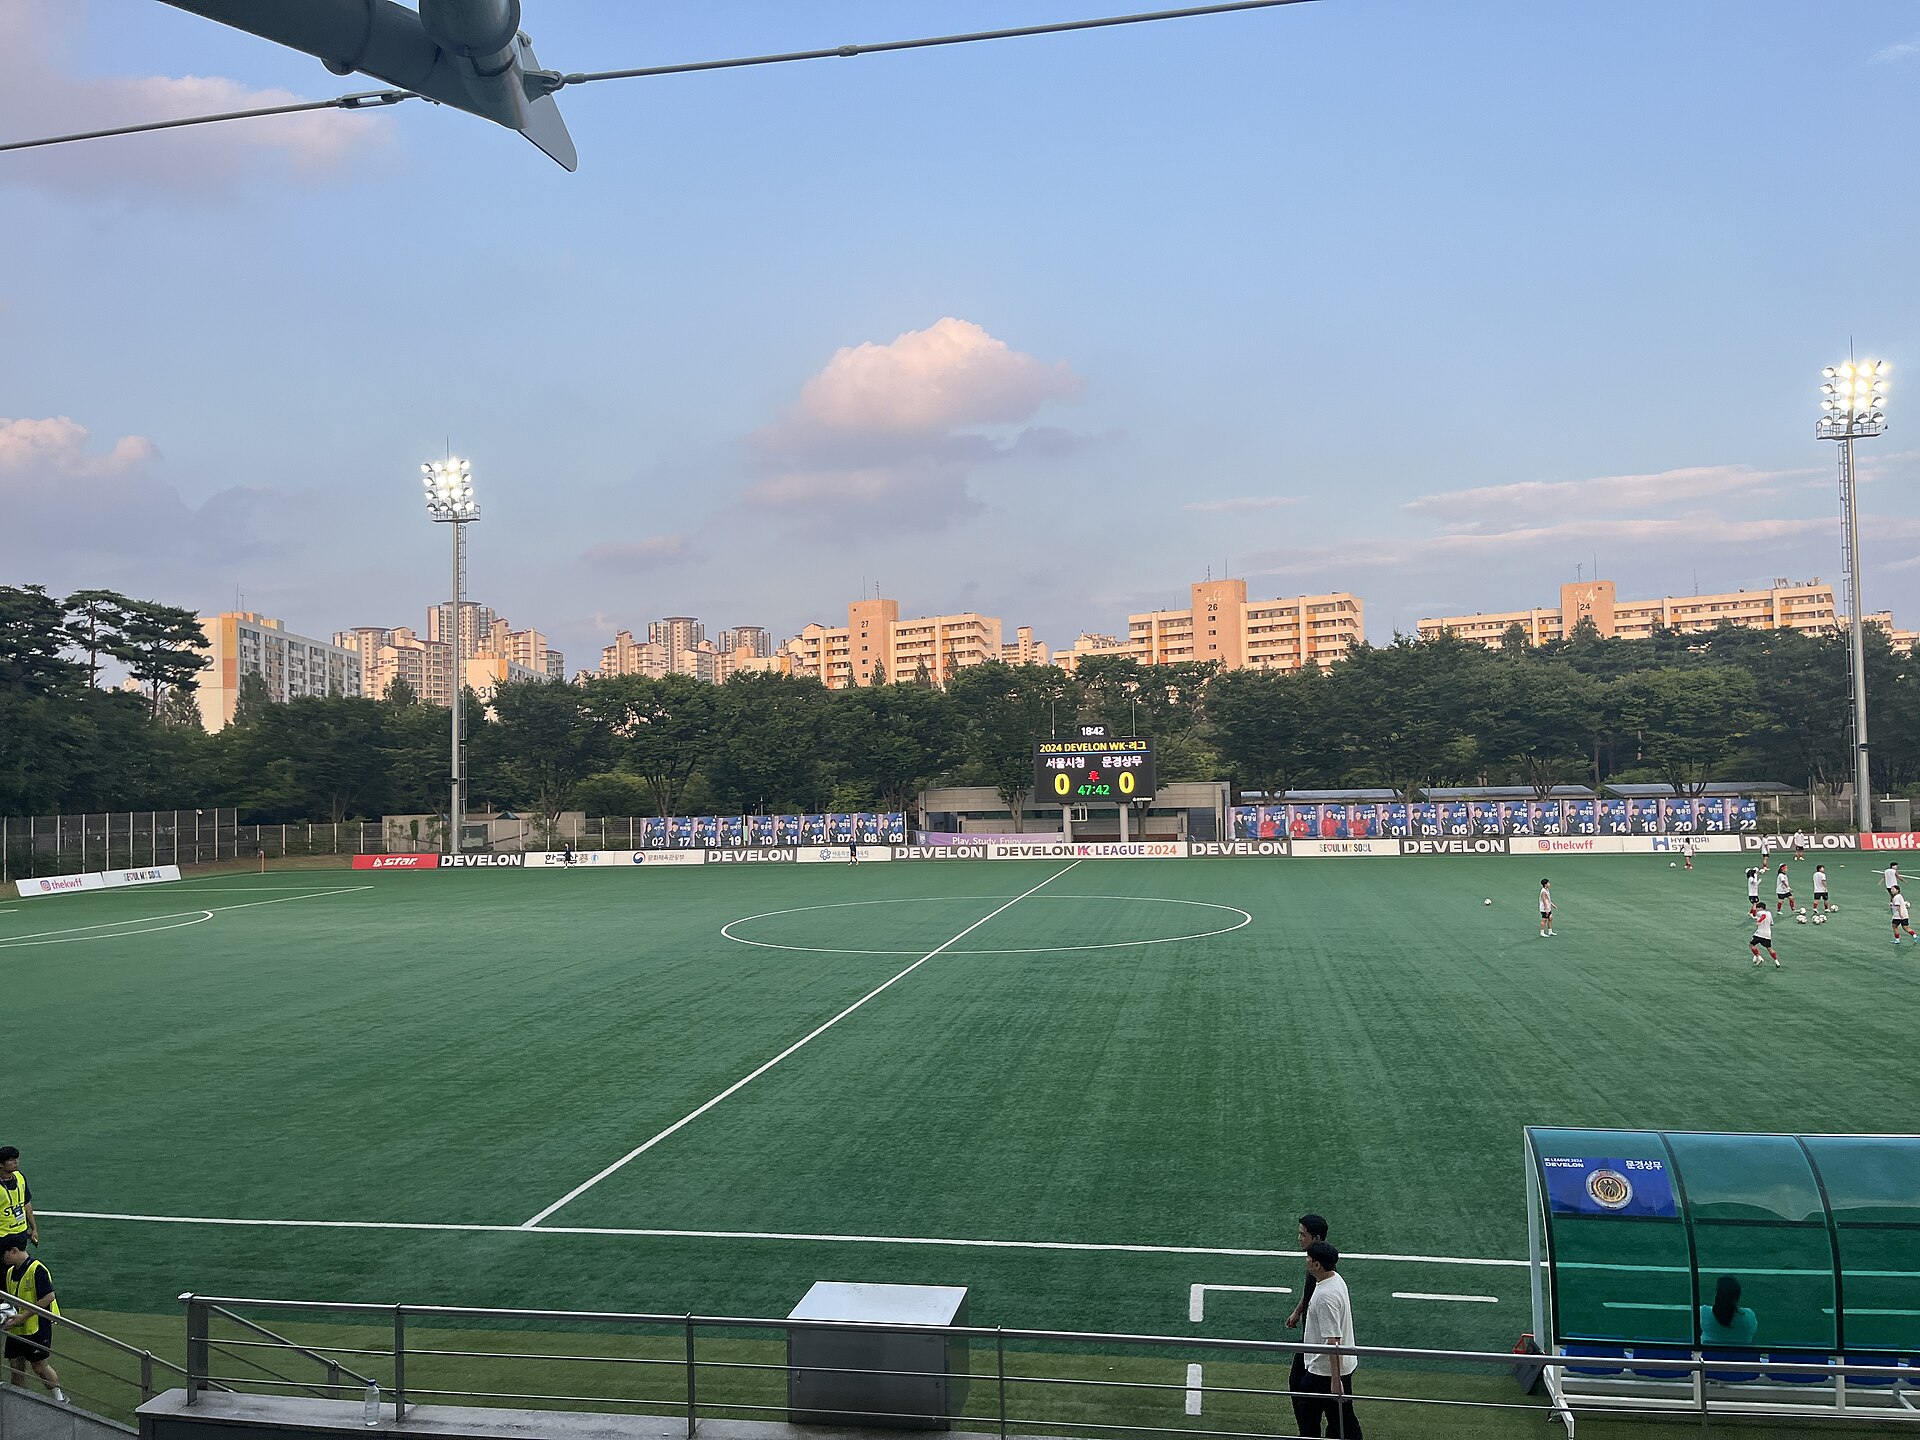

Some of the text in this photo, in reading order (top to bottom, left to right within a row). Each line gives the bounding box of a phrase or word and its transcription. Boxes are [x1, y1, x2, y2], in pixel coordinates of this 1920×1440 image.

[1207, 603, 1218, 611] 26
[861, 620, 869, 628] 27
[478, 686, 493, 698] 31
[1081, 726, 1105, 736] 18:42
[1040, 741, 1147, 752] 2024 DEVELON WK-리그
[1046, 756, 1085, 769] 서울시청
[1101, 755, 1143, 768] 문경상무
[1054, 773, 1070, 795] 0
[1118, 771, 1135, 794] 0
[1077, 784, 1111, 796] 47:42
[1421, 824, 1437, 835] 05
[1451, 824, 1467, 835] 06
[1483, 824, 1499, 833] 23
[1513, 823, 1529, 833] 24
[1543, 823, 1560, 834] 26
[1579, 822, 1594, 833] 13
[1610, 822, 1626, 832] 14
[1642, 821, 1657, 832] 16
[1675, 821, 1692, 831] 20
[1706, 820, 1723, 831] 21
[1740, 820, 1756, 830] 22
[1391, 826, 1406, 835] 01
[652, 837, 664, 846] 02
[678, 837, 690, 846] 17
[703, 837, 716, 846] 18
[729, 836, 741, 845] 19
[760, 836, 772, 845] 10
[785, 836, 798, 844] 11
[811, 834, 824, 843] 12
[837, 834, 851, 842] 07
[864, 833, 877, 842] 08
[889, 833, 903, 842] 09
[1745, 835, 1856, 849] DEVELON
[1191, 842, 1287, 856] DEVELON
[1319, 844, 1341, 852] SEOUL
[1353, 843, 1371, 852] SOUL
[1403, 840, 1505, 854] DEVELON
[1552, 840, 1594, 850] thekwff
[708, 849, 794, 862] DEVELON
[895, 846, 983, 859] DEVELON
[996, 846, 1075, 857] DEVELON
[1096, 844, 1145, 856] LEAGUE
[1147, 844, 1177, 855] 2024
[440, 854, 522, 867] DEVELON
[51, 878, 82, 889] thekwff
[1625, 1160, 1663, 1170] 문경상무
